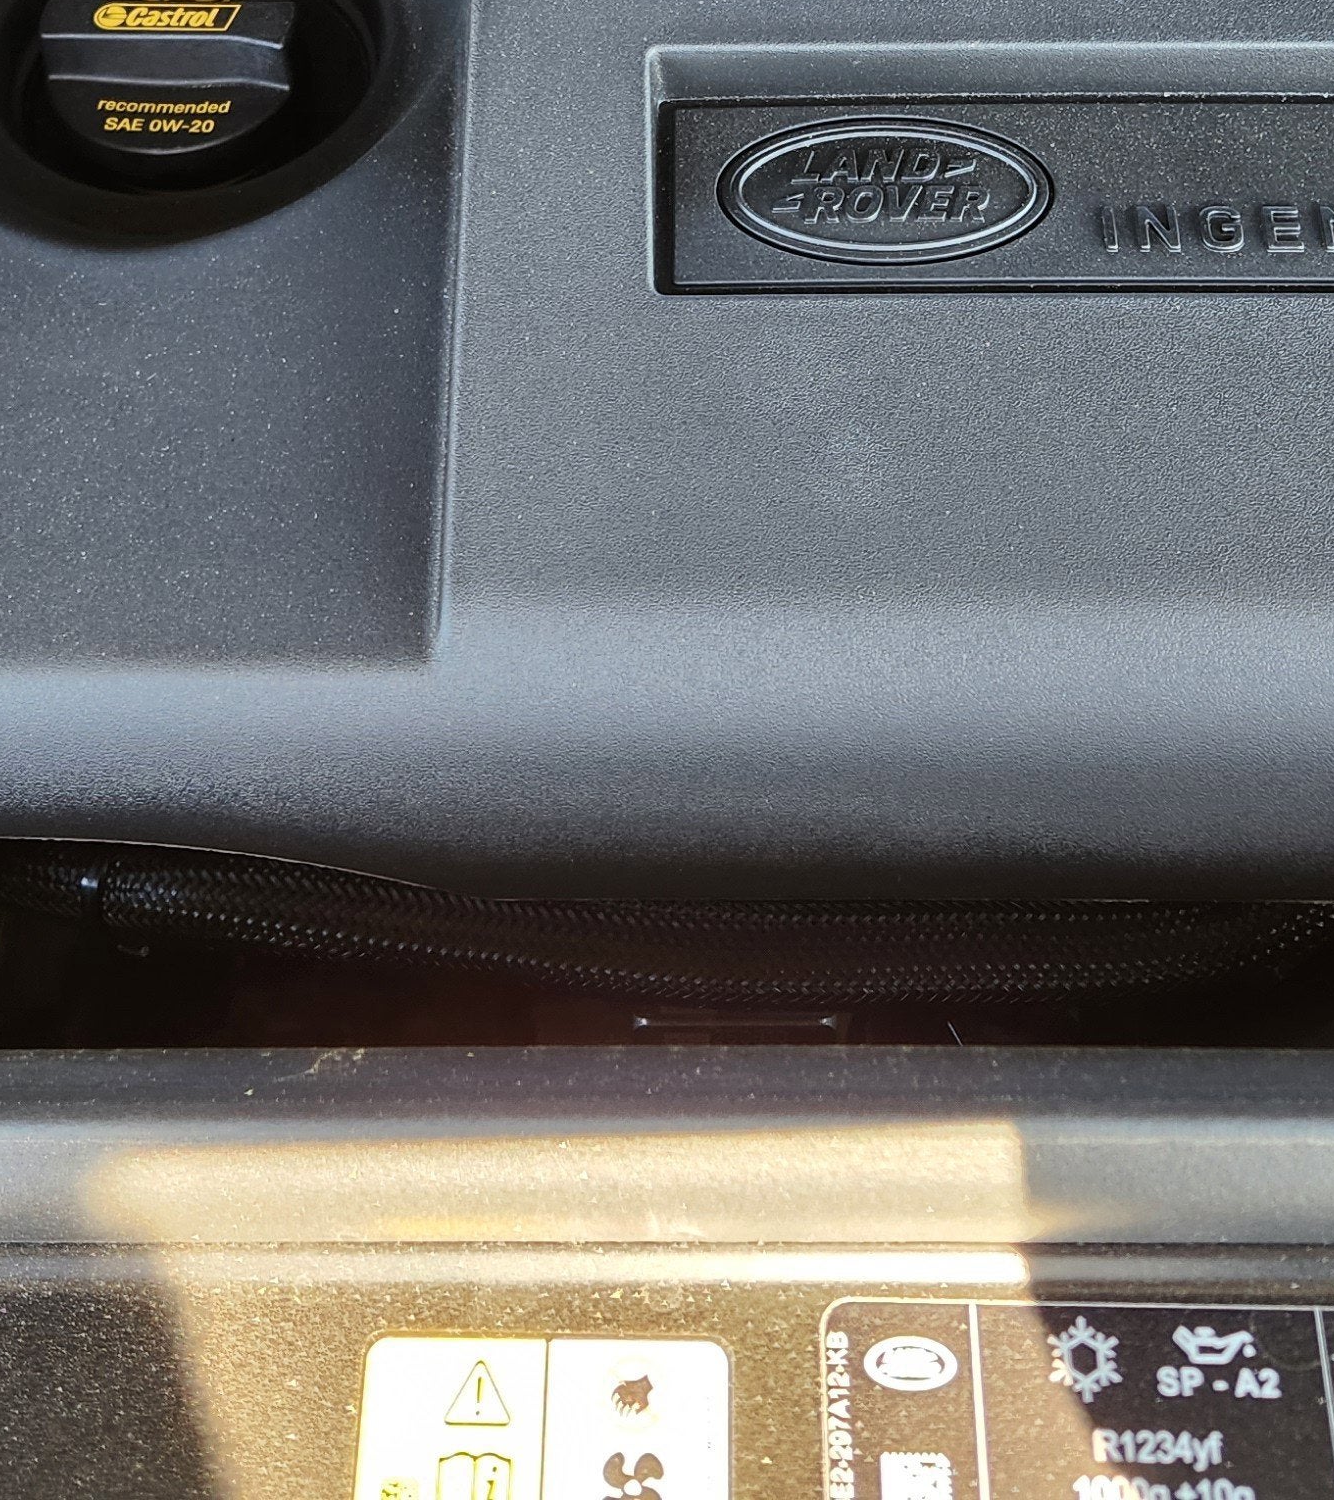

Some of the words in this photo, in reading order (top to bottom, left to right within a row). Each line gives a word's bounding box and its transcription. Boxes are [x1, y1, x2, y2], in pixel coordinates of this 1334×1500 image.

[126, 7, 219, 27] Castrol
[97, 100, 231, 115] recommended
[104, 117, 143, 133] SAE
[1156, 1366, 1204, 1397] SP
[1234, 1367, 1283, 1399] A2
[1092, 1428, 1224, 1472] R1234yf
